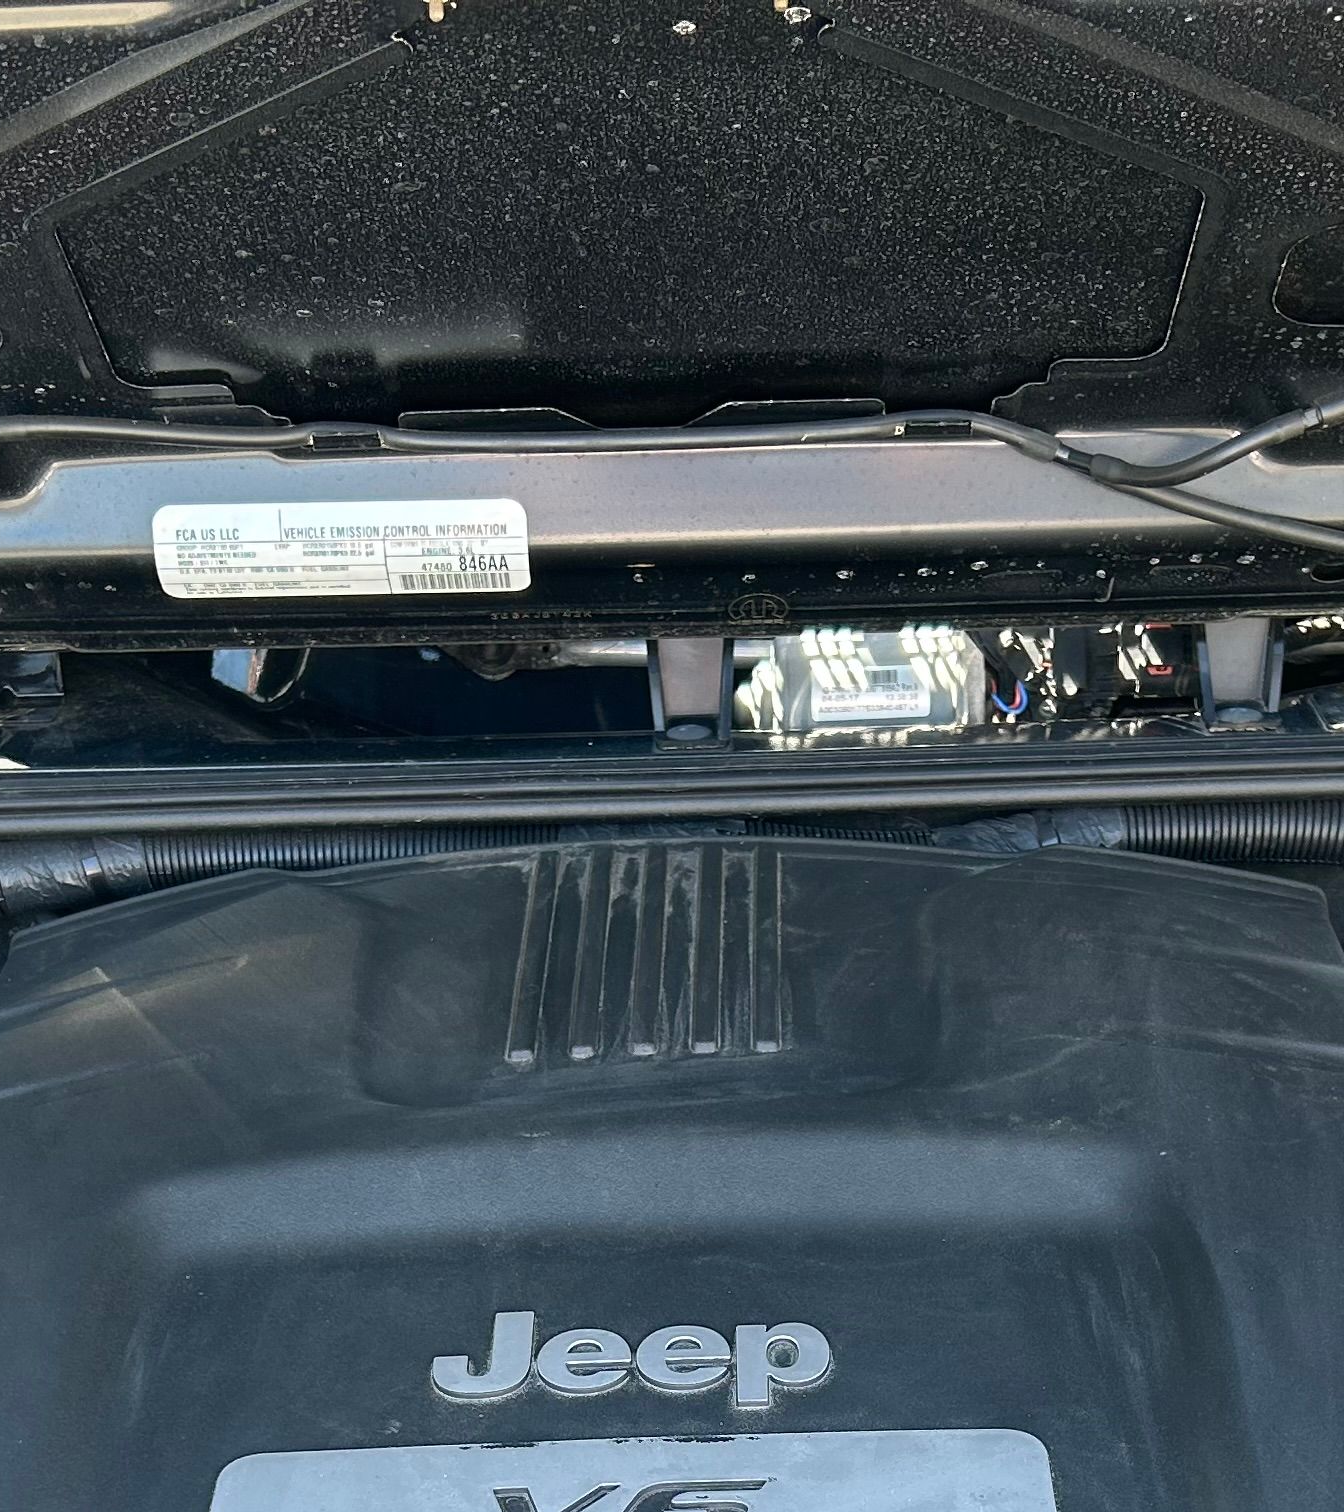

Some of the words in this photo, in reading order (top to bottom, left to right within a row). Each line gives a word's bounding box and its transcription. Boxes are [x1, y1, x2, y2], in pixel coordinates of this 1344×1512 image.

[176, 529, 196, 541] FCA
[201, 529, 216, 541] US
[220, 528, 240, 540] LLC
[283, 527, 326, 540] VEHICLE
[330, 526, 380, 539] EMISSION
[384, 525, 431, 537] CONTROL
[435, 523, 508, 537] INFORMATION
[459, 556, 509, 572] 846AA
[432, 1311, 833, 1409] Jeep
